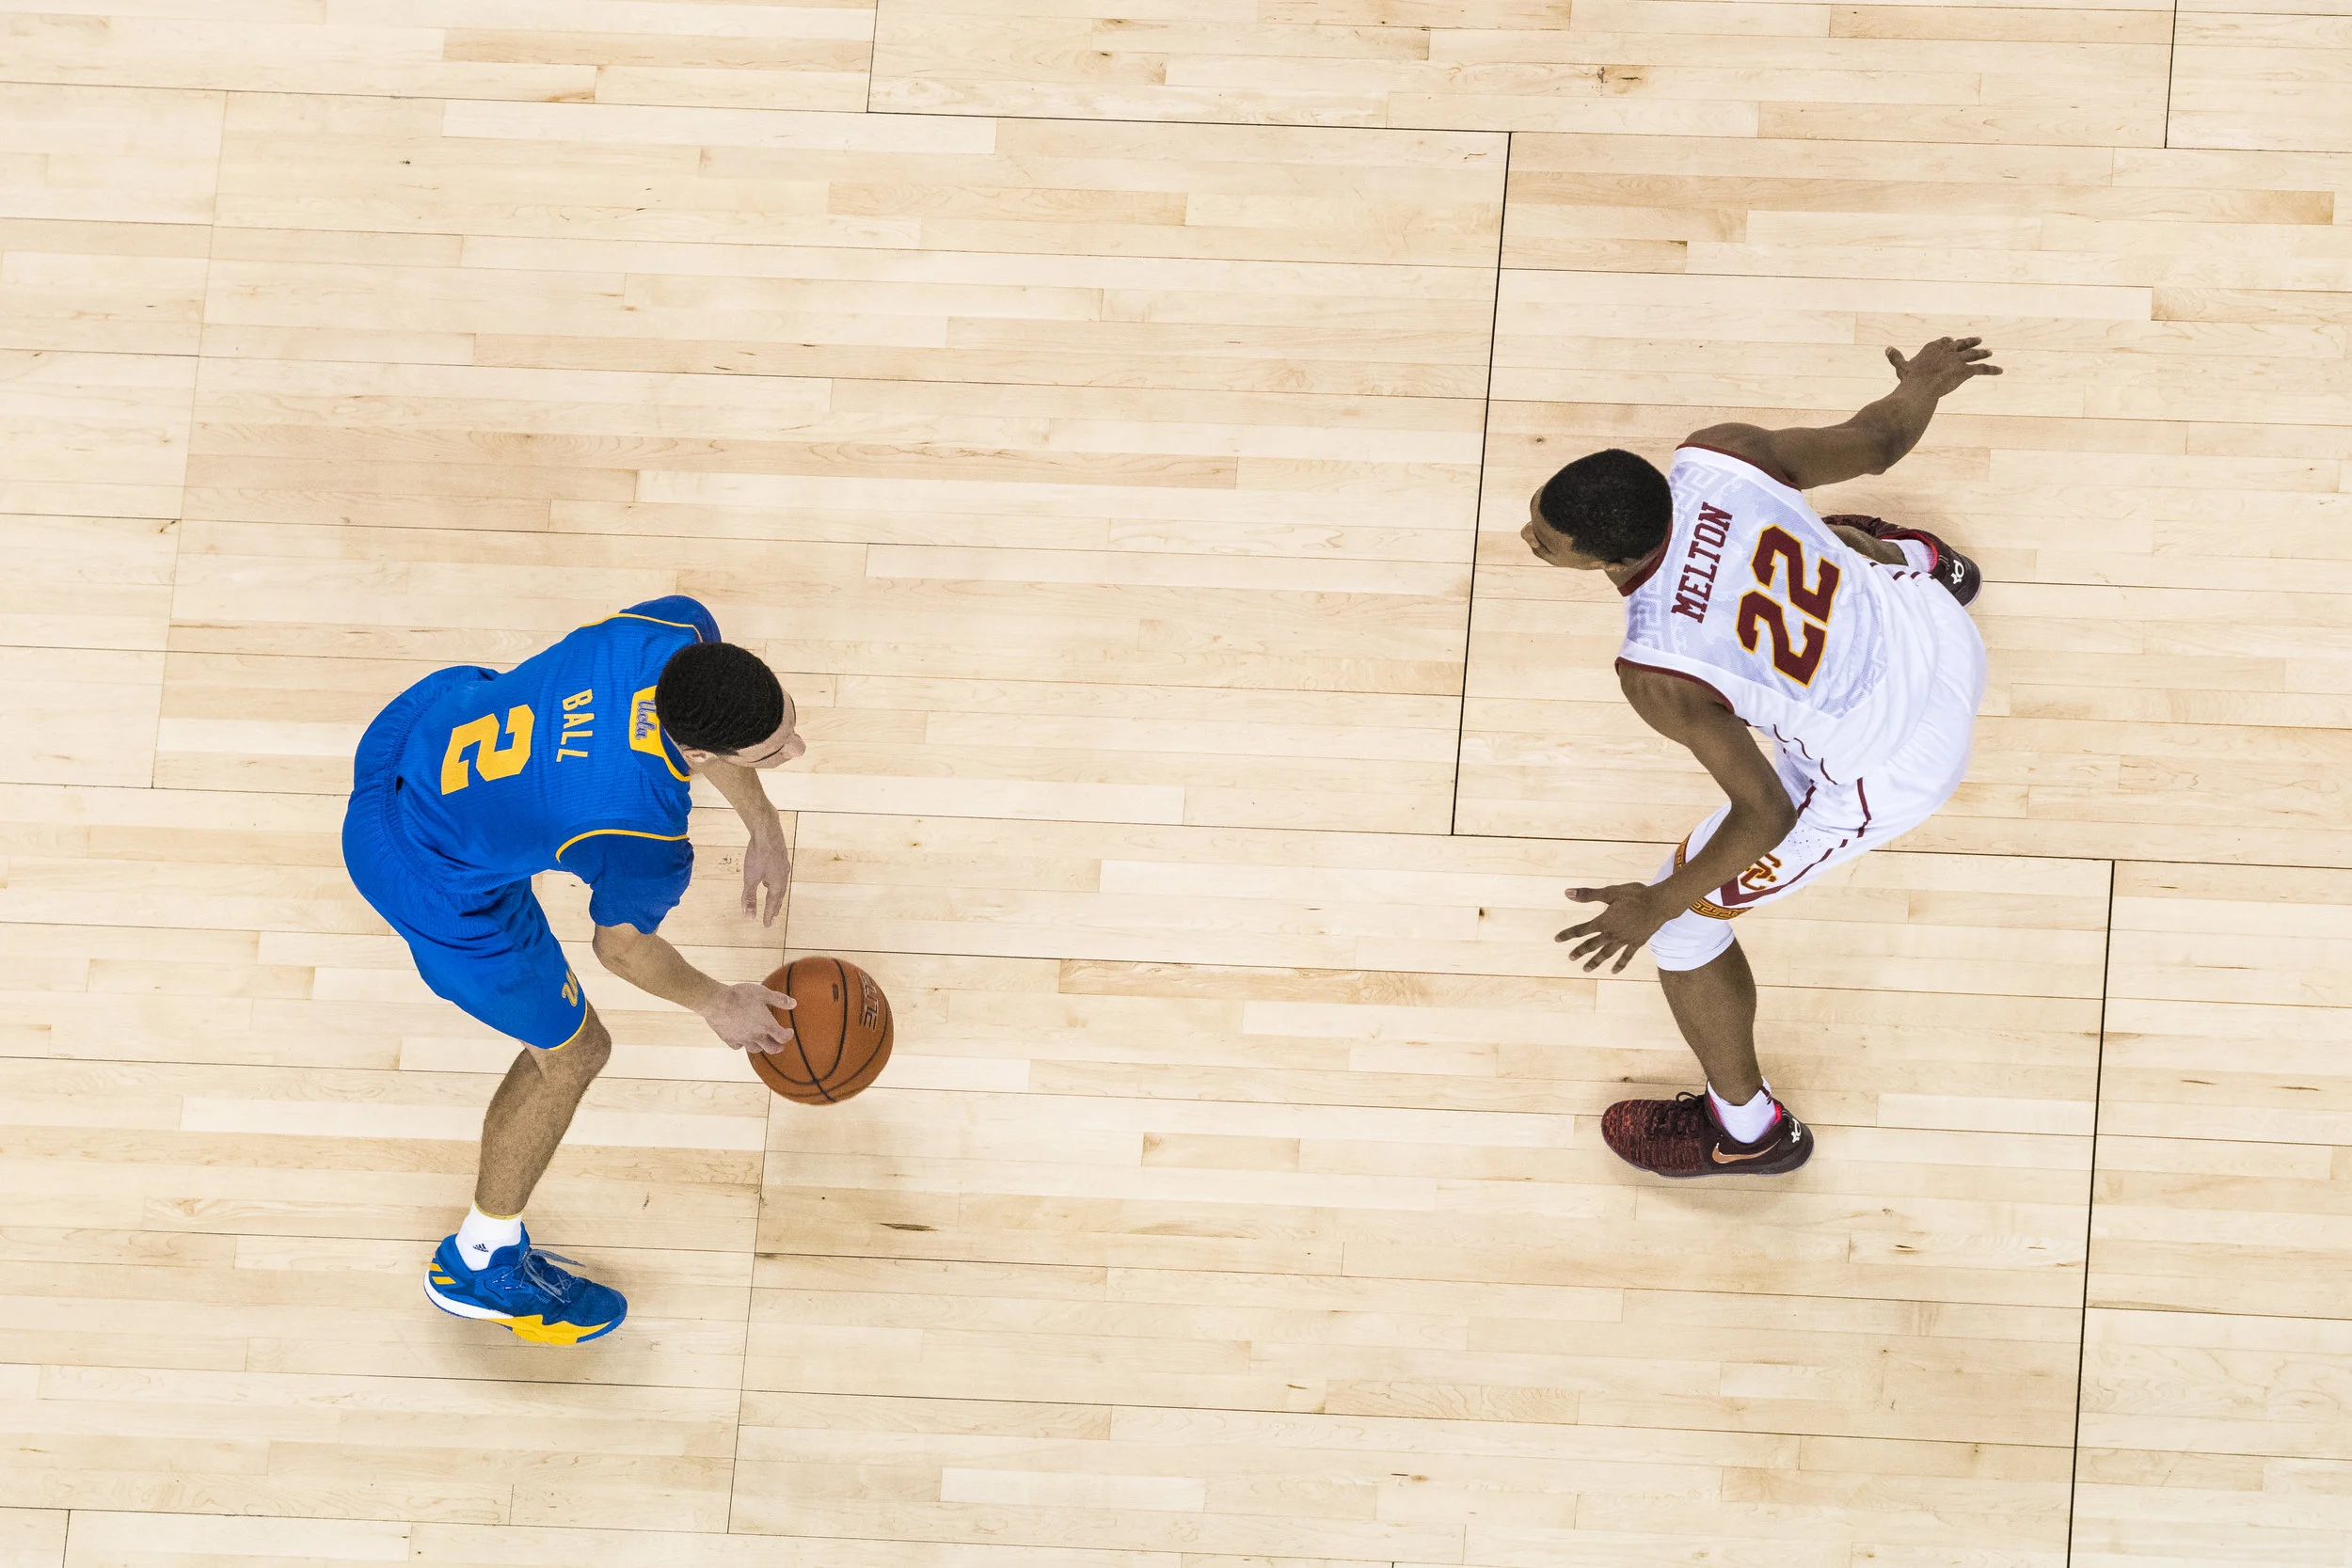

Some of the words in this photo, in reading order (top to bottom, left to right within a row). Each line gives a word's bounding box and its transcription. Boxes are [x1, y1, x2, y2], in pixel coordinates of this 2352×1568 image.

[1671, 501, 1733, 625] MELTON
[1734, 523, 1842, 689] 22
[440, 704, 535, 796] 2
[556, 689, 595, 763] BALL
